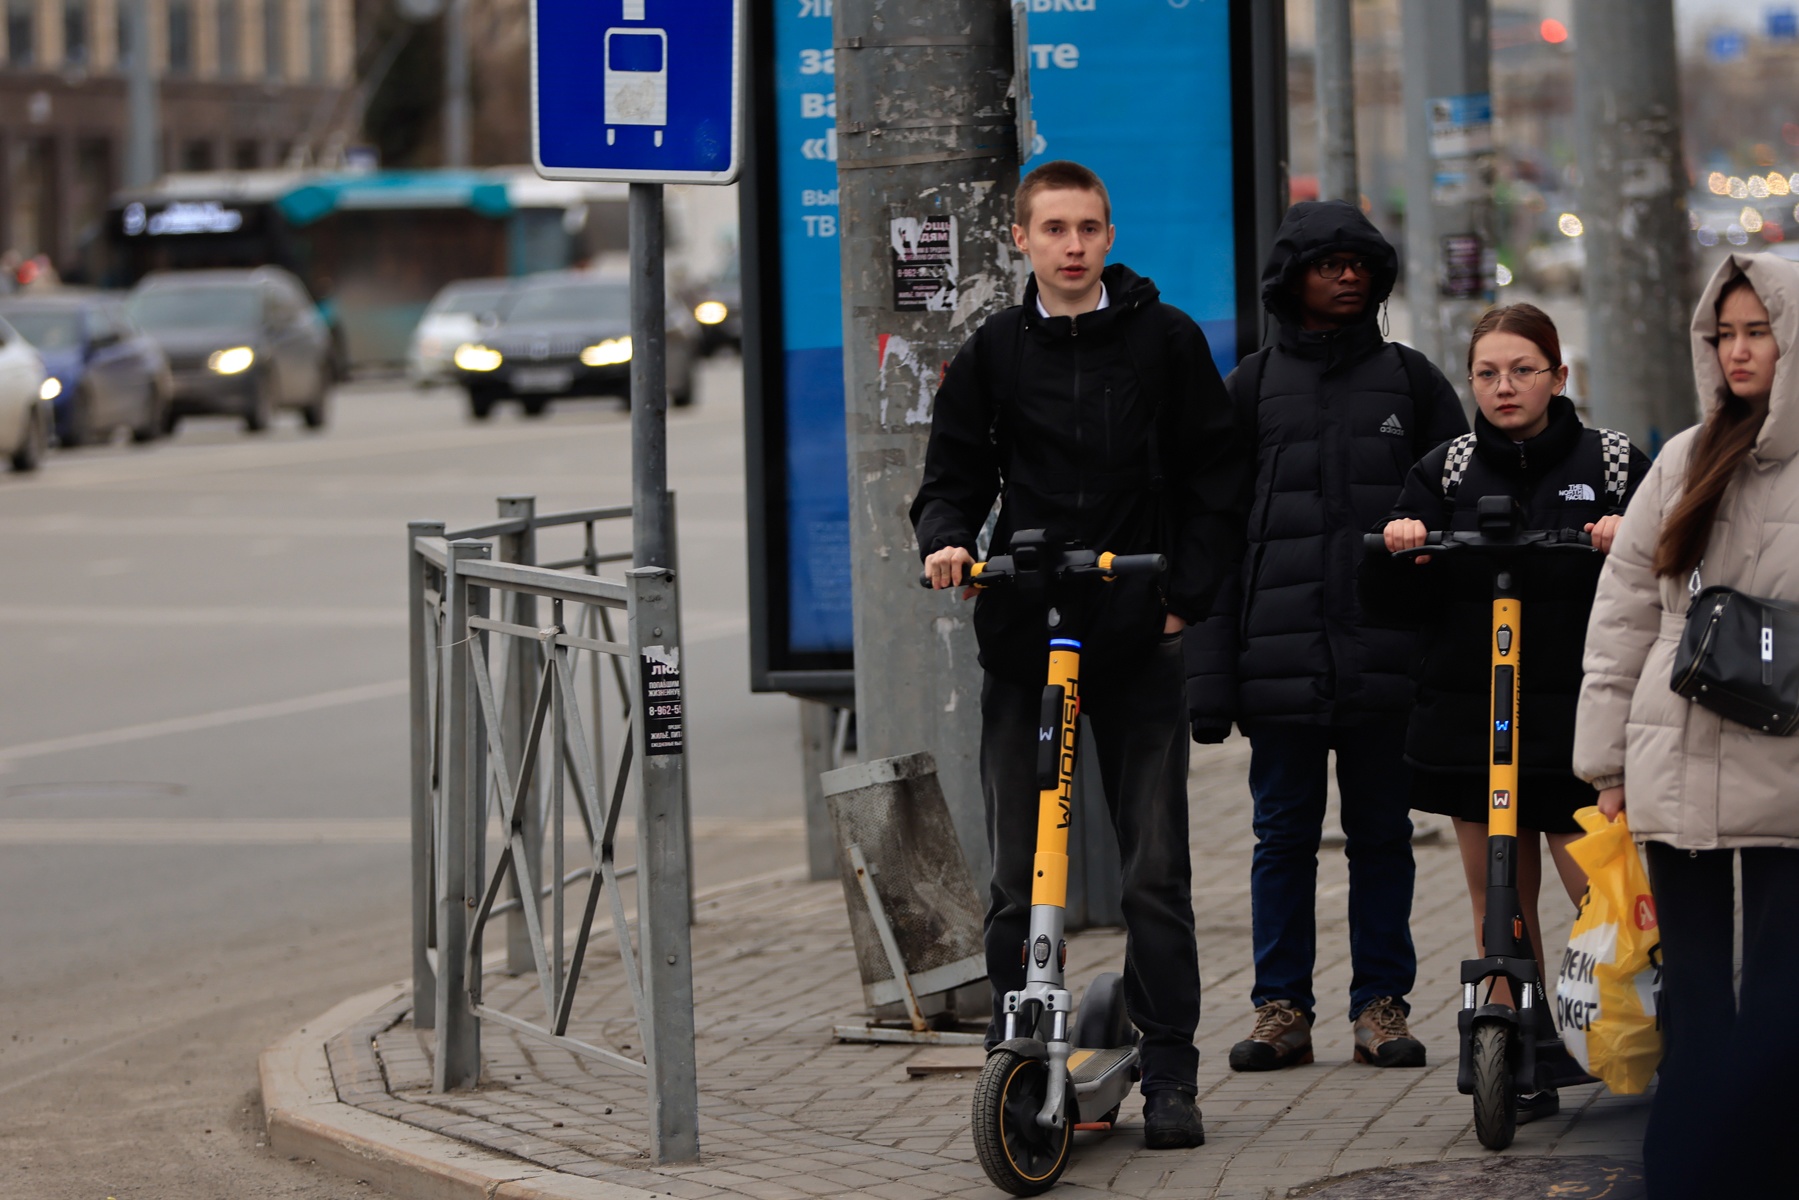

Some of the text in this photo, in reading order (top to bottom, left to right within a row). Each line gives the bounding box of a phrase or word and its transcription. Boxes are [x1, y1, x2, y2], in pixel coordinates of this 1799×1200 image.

[1030, 43, 1080, 70] те
[920, 233, 948, 242] ДЯМ
[1379, 426, 1404, 437] adidas
[1559, 489, 1582, 497] NORTH
[1056, 677, 1079, 829] WHOOSH
